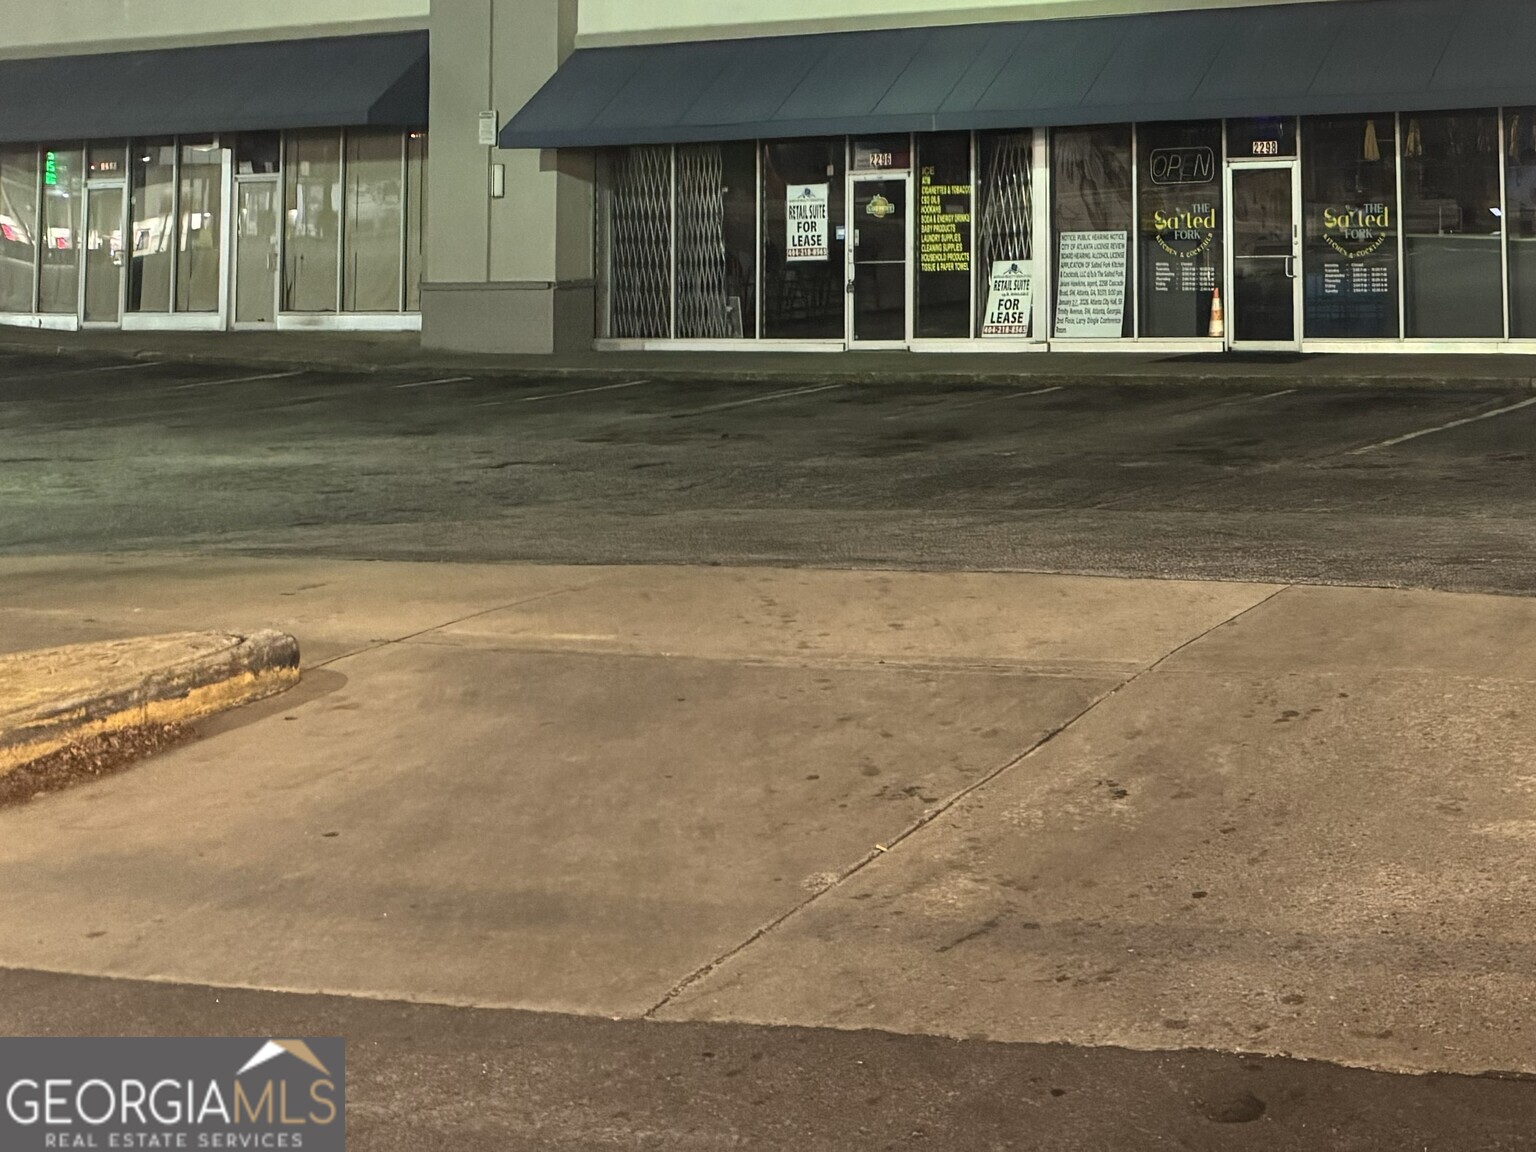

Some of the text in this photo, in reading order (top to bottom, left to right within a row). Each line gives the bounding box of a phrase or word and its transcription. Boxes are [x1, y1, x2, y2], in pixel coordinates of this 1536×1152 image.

[1253, 142, 1276, 153] 2298
[922, 166, 935, 175] ICE
[1153, 154, 1211, 177] OPEN
[789, 204, 825, 220] RETAIL SUITE
[1192, 203, 1210, 213] THE
[1364, 203, 1383, 213] THE
[797, 221, 817, 233] FOR
[933, 224, 956, 233] PRODUCTS
[1174, 230, 1201, 240] FORK
[1344, 229, 1373, 239] FORK
[792, 235, 822, 247] LEASE
[1155, 234, 1177, 255] KITCHEN
[1186, 232, 1213, 258] COCKTAILS
[1323, 233, 1347, 256] KITCHEN
[947, 252, 969, 262] PRODUCTS
[993, 279, 1030, 291] RETAIL SUITE
[997, 298, 1020, 311] FOR
[990, 312, 1024, 324] LEASE
